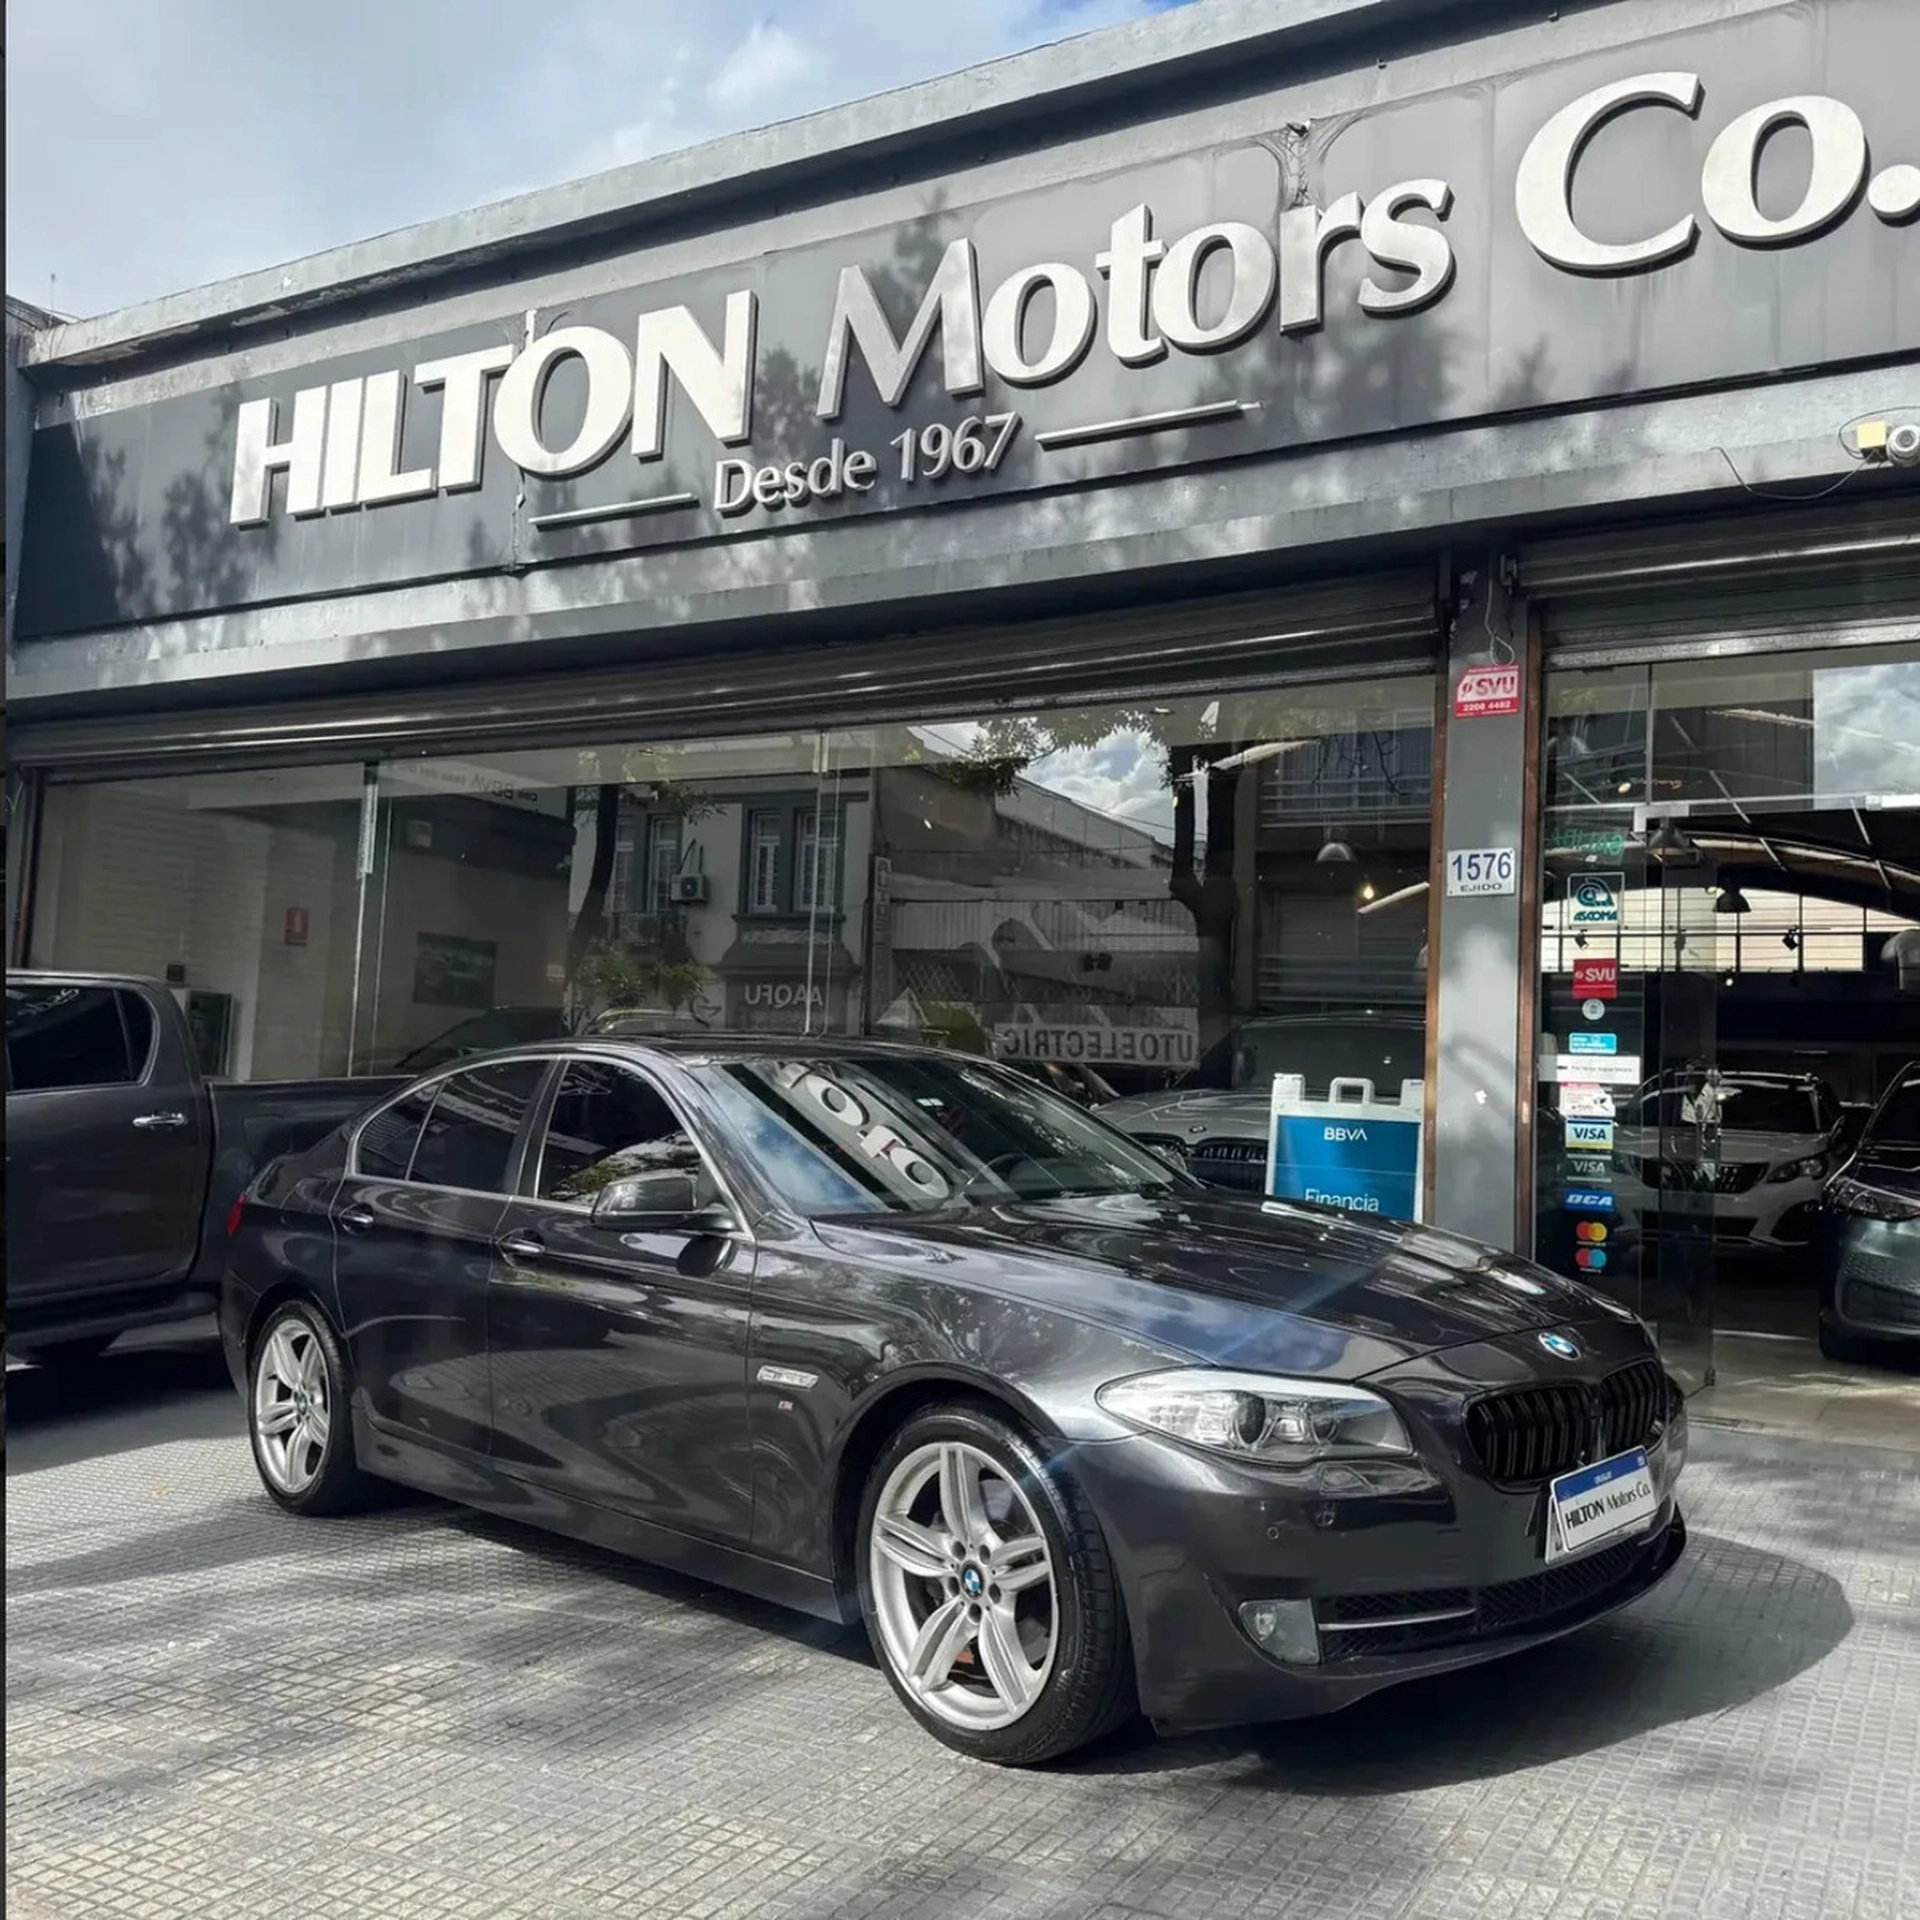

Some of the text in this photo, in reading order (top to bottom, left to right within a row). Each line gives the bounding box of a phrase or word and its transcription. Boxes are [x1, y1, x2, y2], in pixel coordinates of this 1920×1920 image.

[230, 71, 1920, 527] HILTON Motors Co.
[713, 411, 1022, 515] Desde 1967
[1475, 676, 1515, 696] SVU
[1452, 851, 1512, 881] 1576
[1459, 883, 1502, 893] EJIDO
[1573, 911, 1618, 922] ASCOMA
[1585, 968, 1616, 982] SVU
[1323, 1127, 1368, 1141] BBVA
[1573, 1127, 1607, 1140] VISA
[1573, 1160, 1606, 1174] VISA
[1565, 1498, 1605, 1530] HILTON
[1605, 1486, 1637, 1512] Motors
